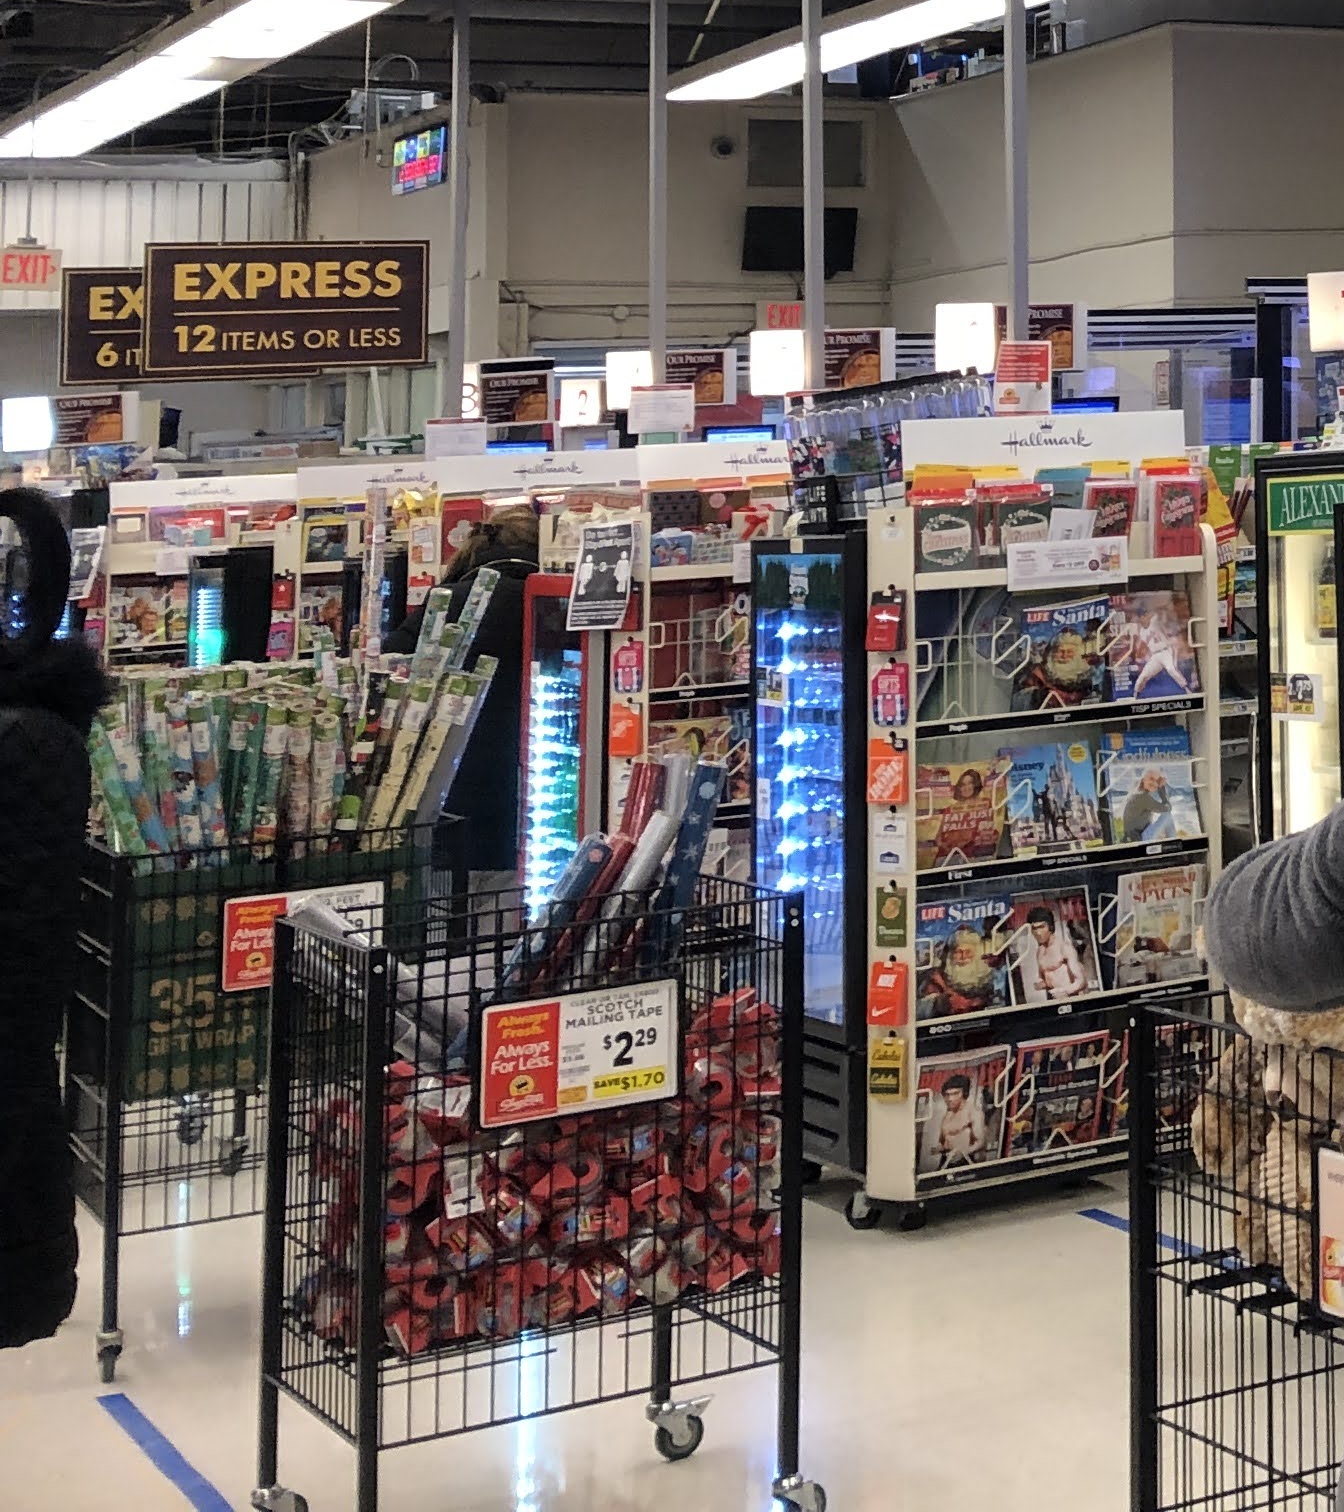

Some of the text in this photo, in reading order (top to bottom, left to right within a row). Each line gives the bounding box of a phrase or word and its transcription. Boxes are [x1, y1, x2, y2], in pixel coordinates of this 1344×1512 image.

[1, 254, 50, 284] EXIT
[173, 260, 402, 302] EXPRESS
[767, 304, 801, 329] EXIT
[173, 325, 402, 353] 12 ITEMS OR LESS
[97, 342, 119, 368] 6
[685, 353, 717, 364] PROMISE
[1000, 427, 1093, 457] Hallmark
[724, 450, 791, 472] Hallmar
[1027, 610, 1049, 623] LIFE
[1052, 600, 1106, 626] Santa
[921, 906, 945, 921] LIFE
[948, 897, 1006, 924] Santa
[233, 927, 273, 939] Alway
[565, 1005, 663, 1029] MAILING TAPE
[587, 999, 643, 1015] SCOTCH
[494, 1041, 550, 1060] Always
[490, 1059, 516, 1075] For
[621, 1071, 665, 1091] $1.70
